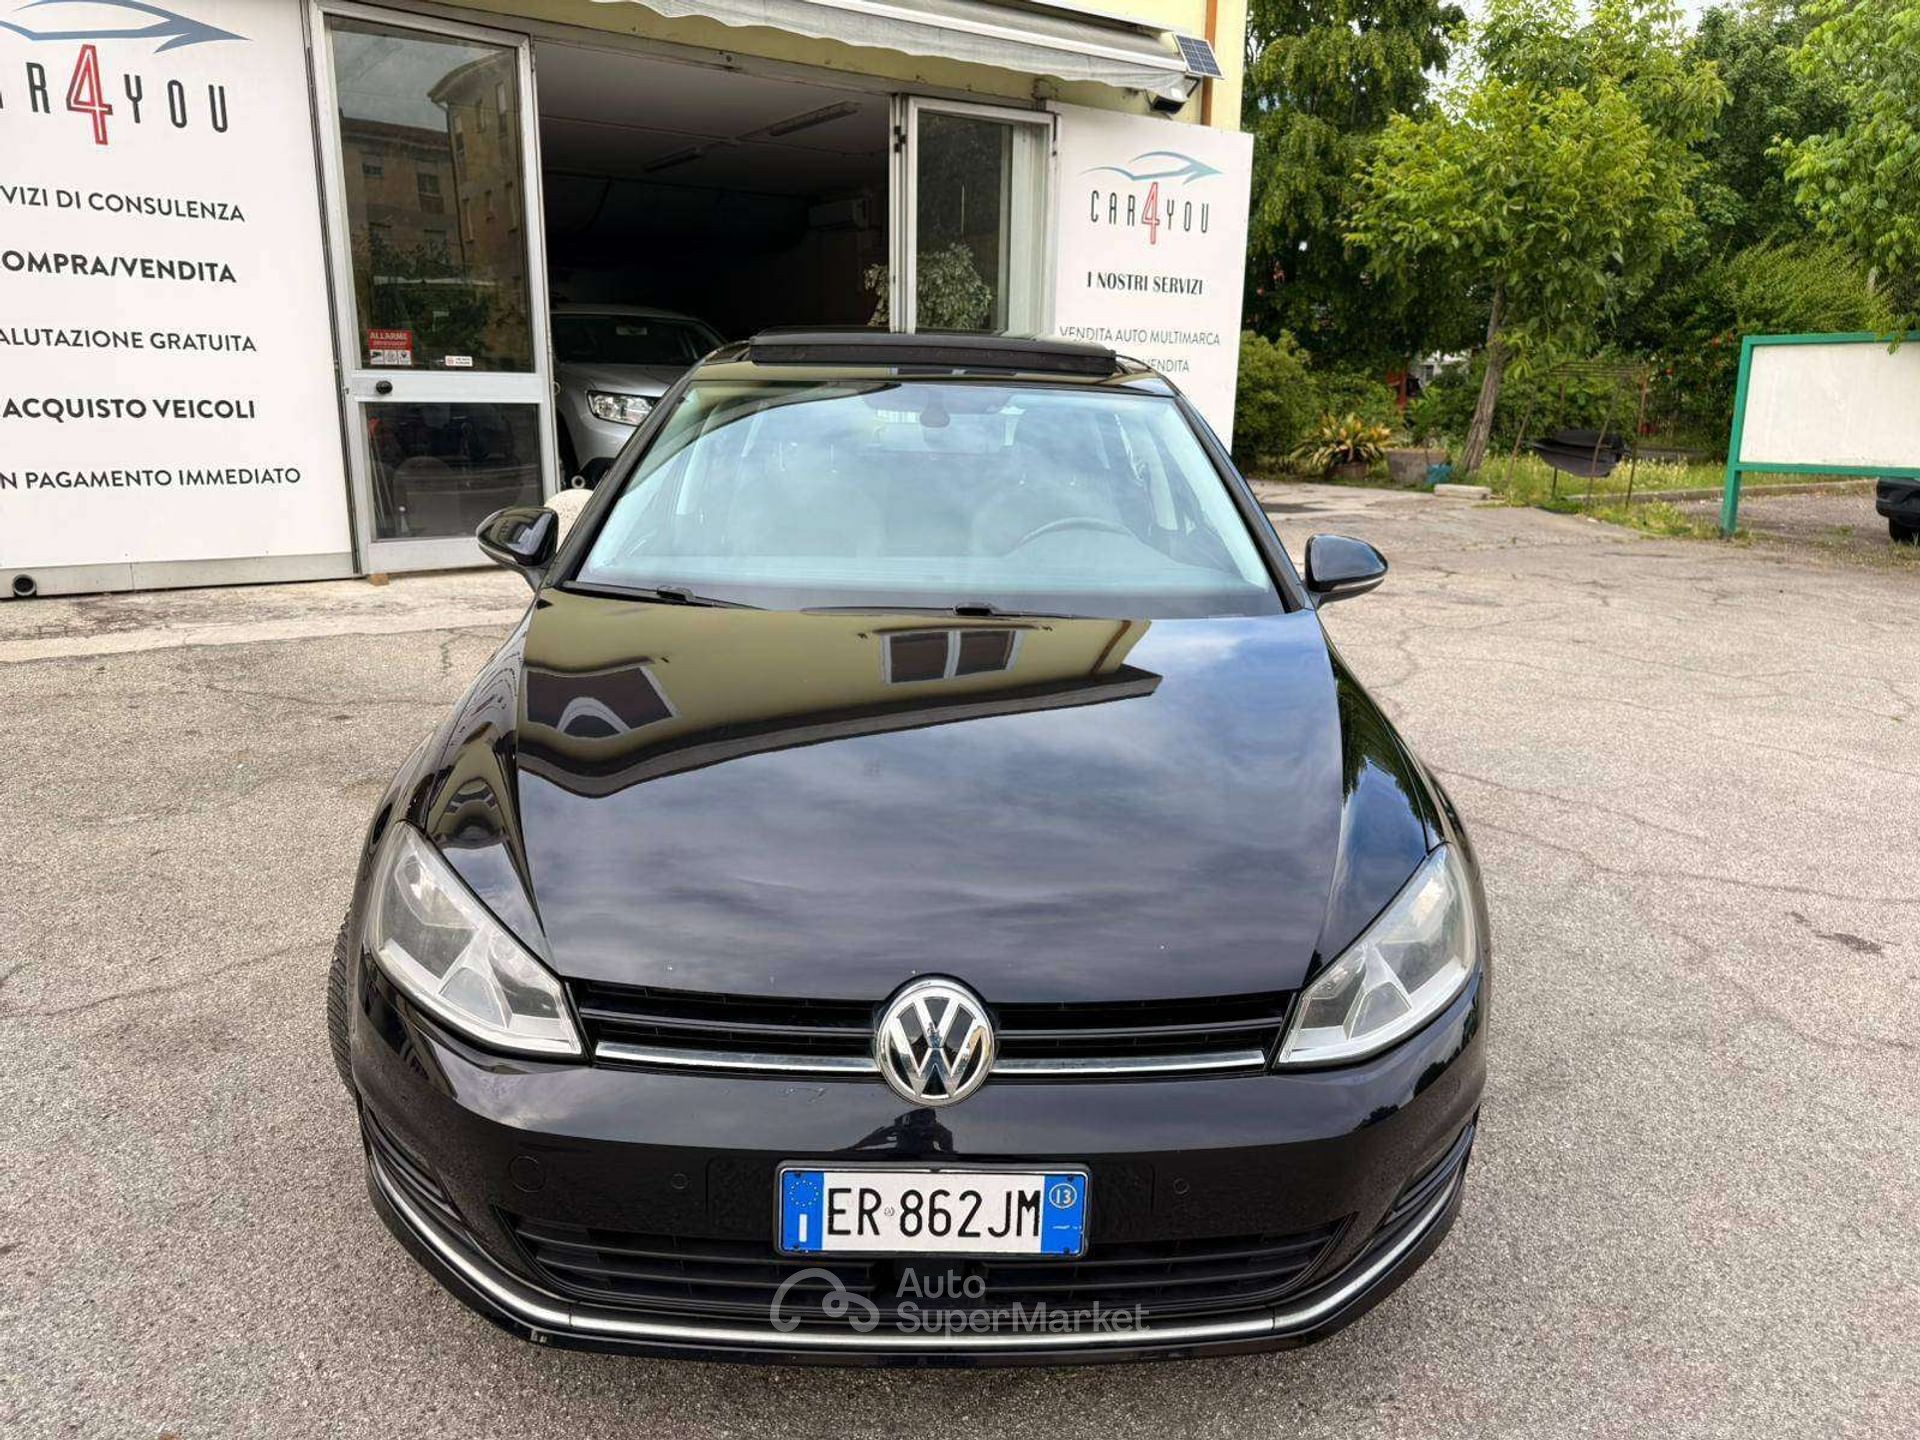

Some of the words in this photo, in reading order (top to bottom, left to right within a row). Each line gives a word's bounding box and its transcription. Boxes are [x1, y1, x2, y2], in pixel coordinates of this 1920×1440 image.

[0, 44, 228, 145] R4YOU
[0, 185, 48, 206] VIZI
[56, 189, 81, 209] DI
[88, 192, 245, 222] CONSULENZA
[1091, 182, 1209, 245] CAR4YOU
[2, 250, 237, 283] OMPRA/VENDITA
[1087, 271, 1093, 288] I
[1097, 272, 1148, 292] NOSTRI
[1152, 276, 1204, 295] SERVIZI
[150, 332, 257, 352] GRATUITA
[1115, 329, 1147, 343] AUTO
[1150, 330, 1221, 346] MULTIMARCA
[3, 398, 147, 423] ACQUISTO
[153, 399, 256, 419] VEICOLI
[25, 470, 172, 489] PAGAMENTO
[178, 467, 301, 487] IMMEDIATO
